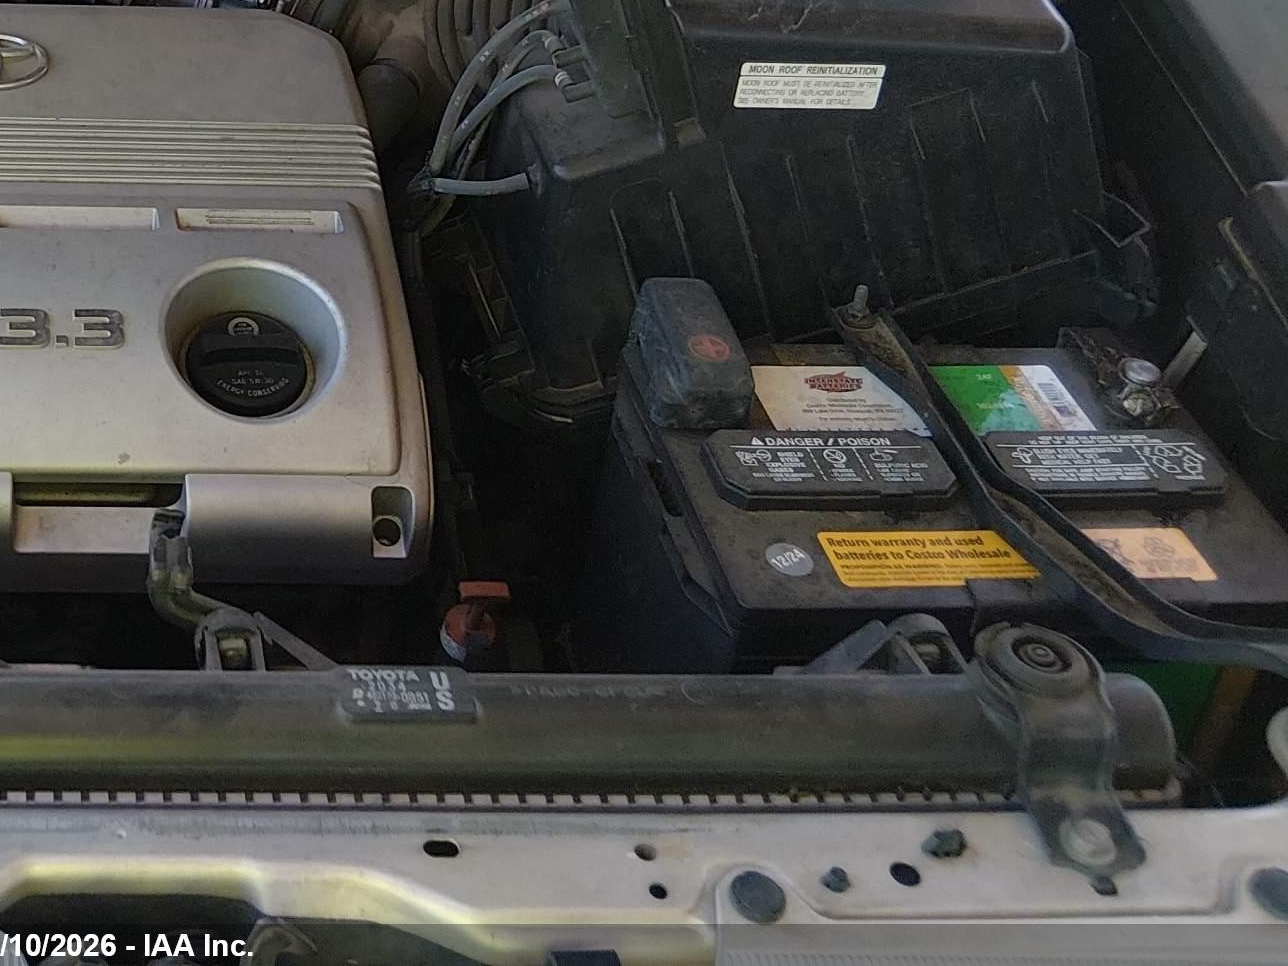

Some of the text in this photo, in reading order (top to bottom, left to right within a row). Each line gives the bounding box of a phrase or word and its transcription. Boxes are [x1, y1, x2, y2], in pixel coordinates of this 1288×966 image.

[748, 65, 878, 75] MOON ROOF REINITIALIZATION
[804, 377, 864, 385] INTERSTATE
[764, 437, 825, 446] DANGER
[838, 437, 892, 446] POISON
[827, 536, 984, 549] Return warranty and used
[769, 548, 807, 569] 12/24
[833, 547, 1011, 561] batteries to Costco Wholesale
[347, 668, 421, 682] TOYOTA
